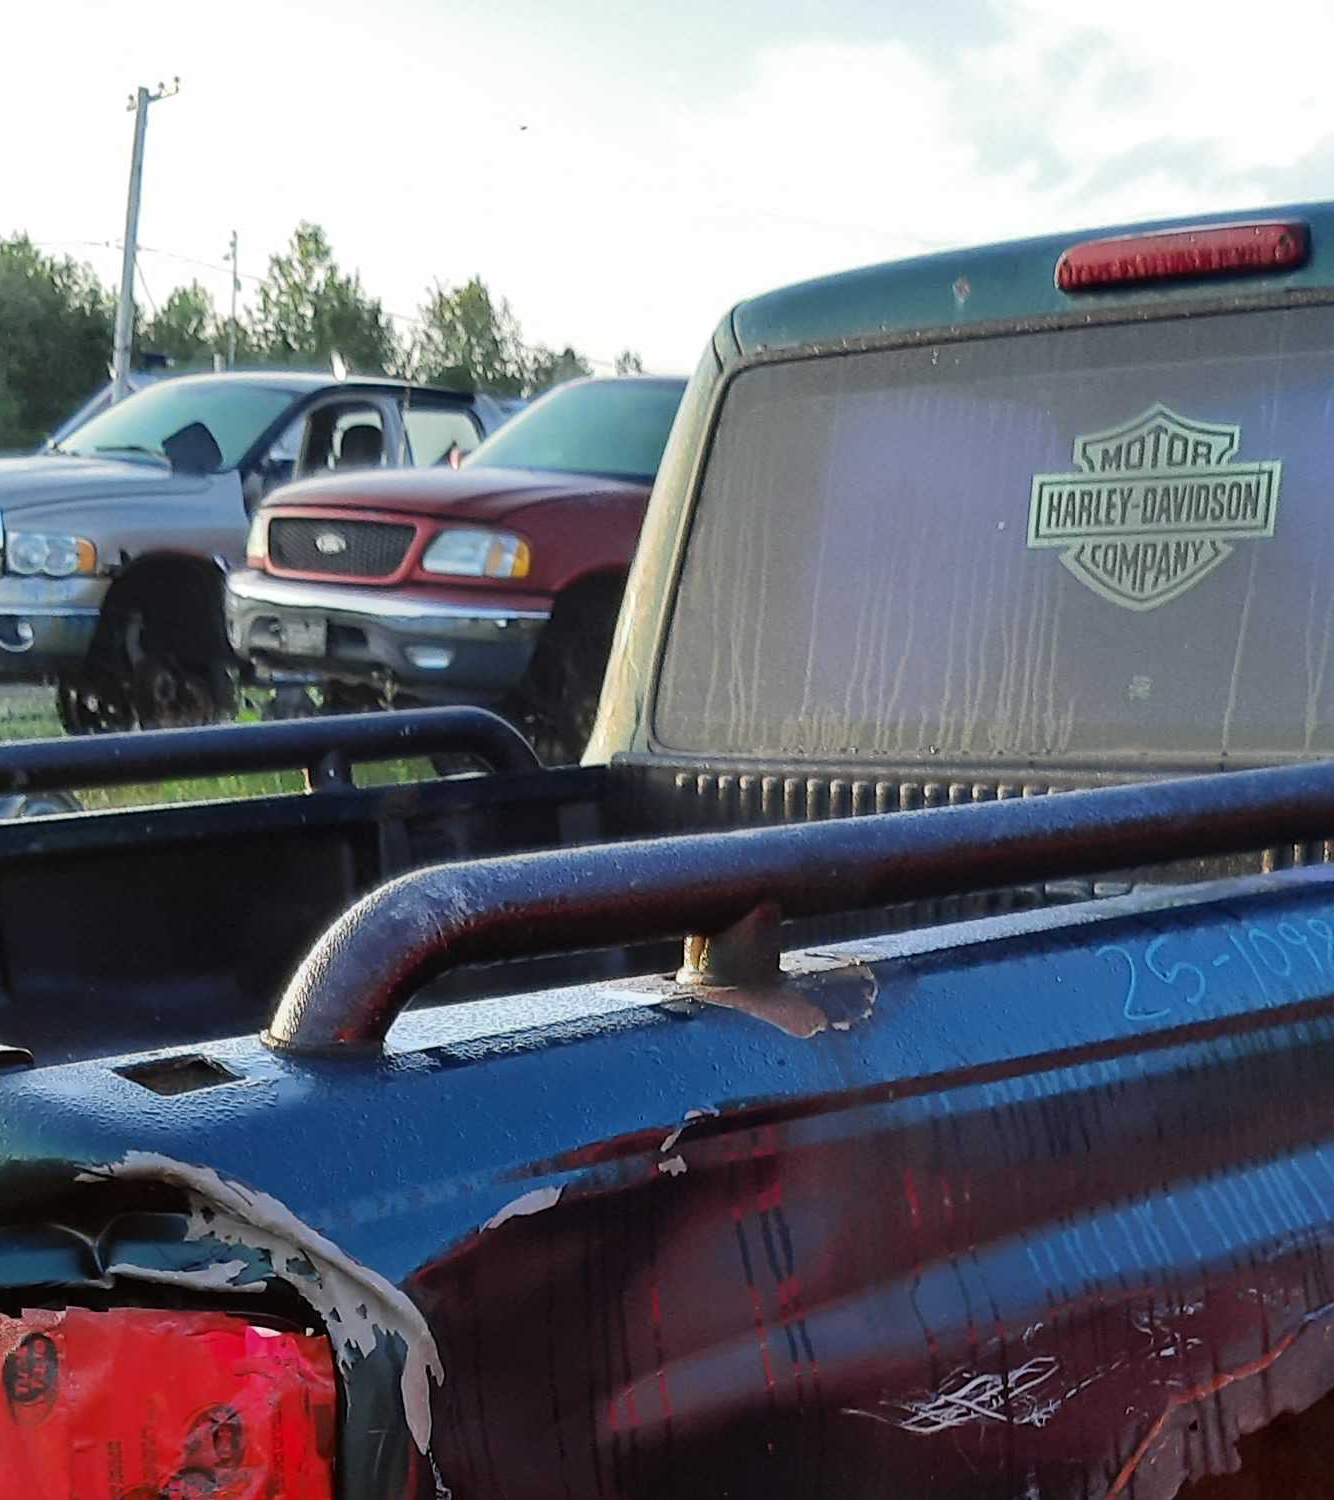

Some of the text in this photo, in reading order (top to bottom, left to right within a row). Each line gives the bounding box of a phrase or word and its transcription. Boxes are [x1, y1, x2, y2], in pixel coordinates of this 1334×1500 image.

[1099, 423, 1213, 472] MOTOR
[1044, 477, 1262, 531] HARLEY-DAVIDSON
[1090, 538, 1205, 594] COMPANY
